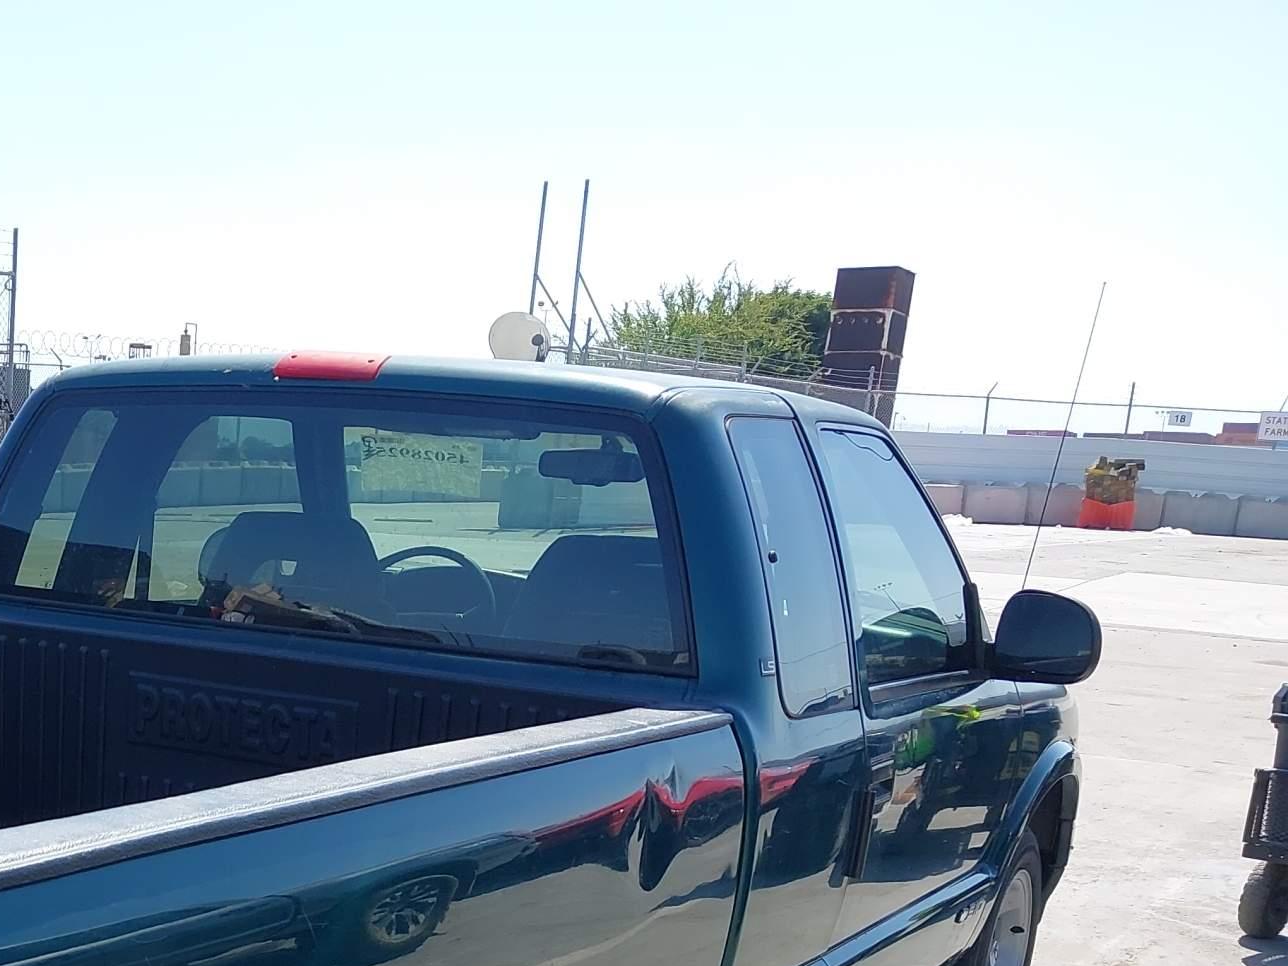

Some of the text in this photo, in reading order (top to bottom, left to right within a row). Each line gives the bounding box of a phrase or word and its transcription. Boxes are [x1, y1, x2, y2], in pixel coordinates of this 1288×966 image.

[1175, 414, 1186, 423] 18
[761, 660, 775, 674] LS
[132, 684, 337, 759] PROTECTA
